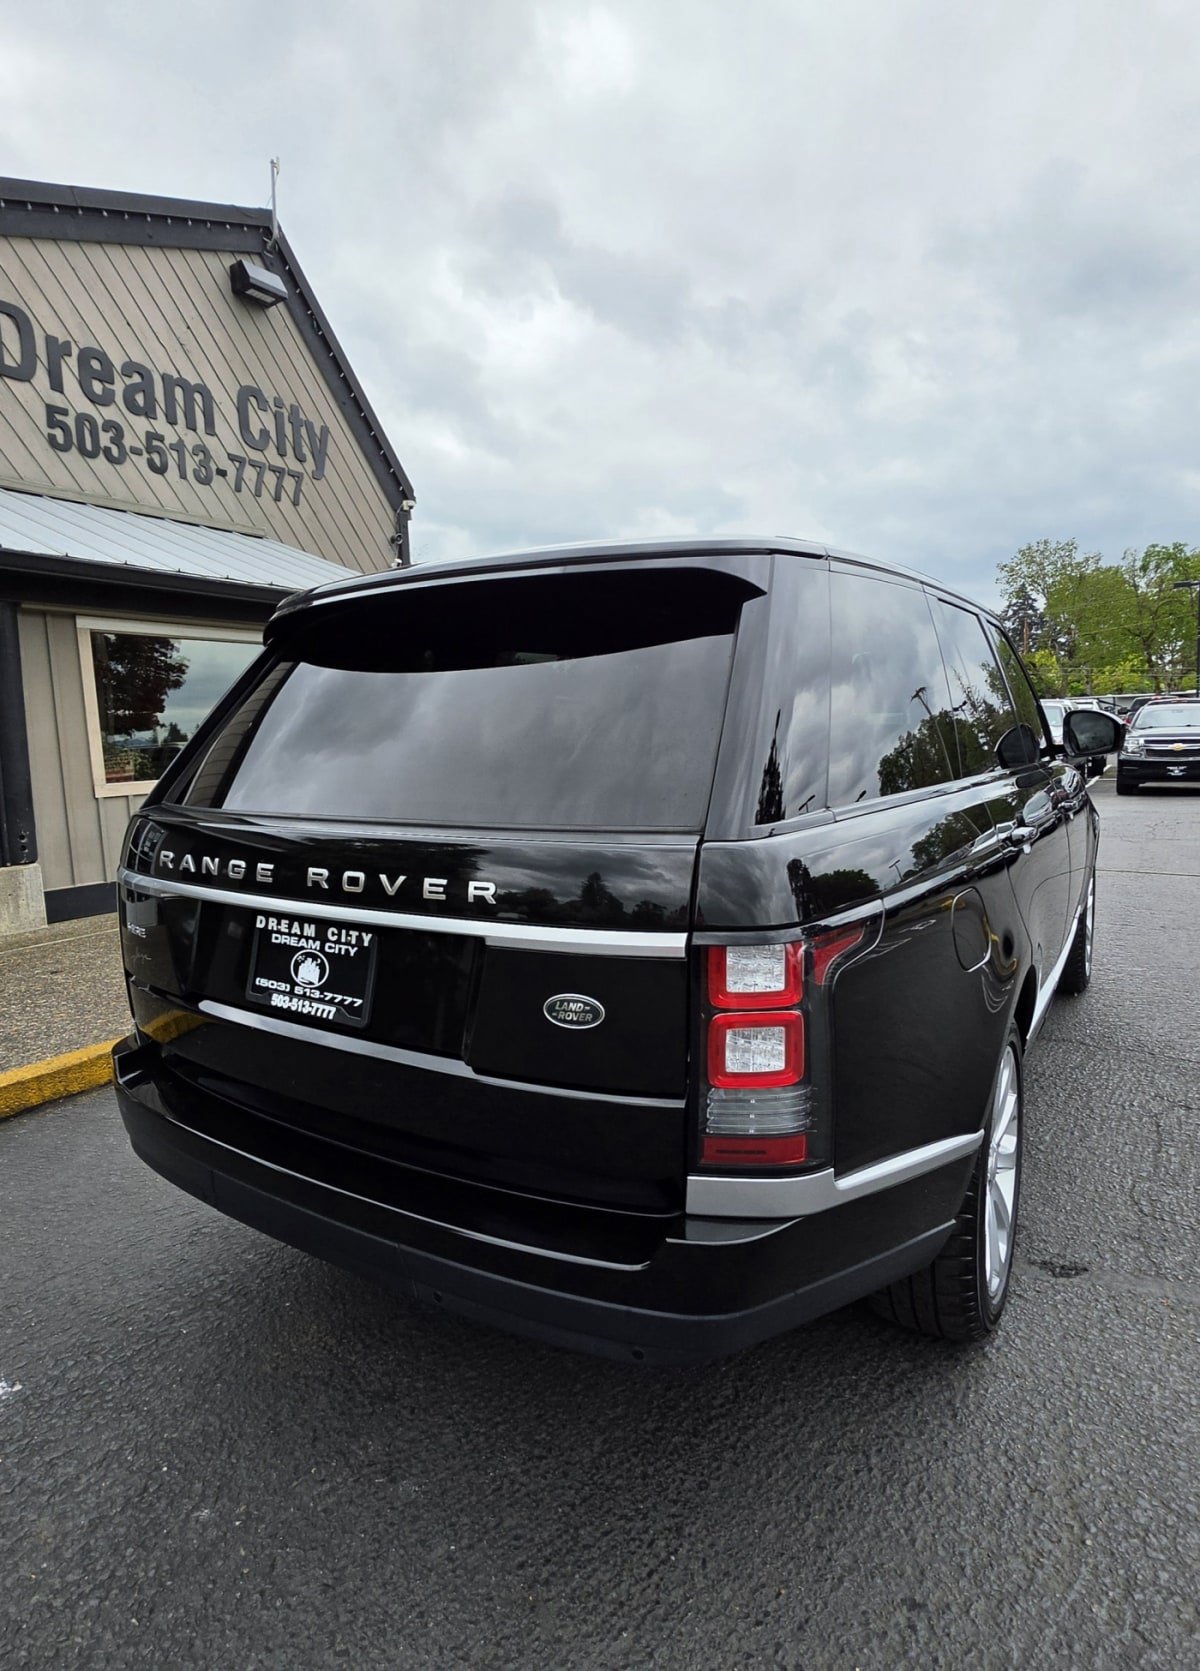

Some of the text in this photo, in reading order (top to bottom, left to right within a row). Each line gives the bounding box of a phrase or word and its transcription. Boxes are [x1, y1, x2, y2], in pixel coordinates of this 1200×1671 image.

[0, 299, 329, 480] Dream City
[46, 404, 304, 506] 503-513-7777
[159, 850, 497, 904] RANGE ROVER
[256, 915, 372, 947] DREAM CITY
[271, 933, 358, 957] DREAM CITY
[255, 977, 363, 1007] (503) 513-7777
[272, 993, 336, 1019] 503-513-7777
